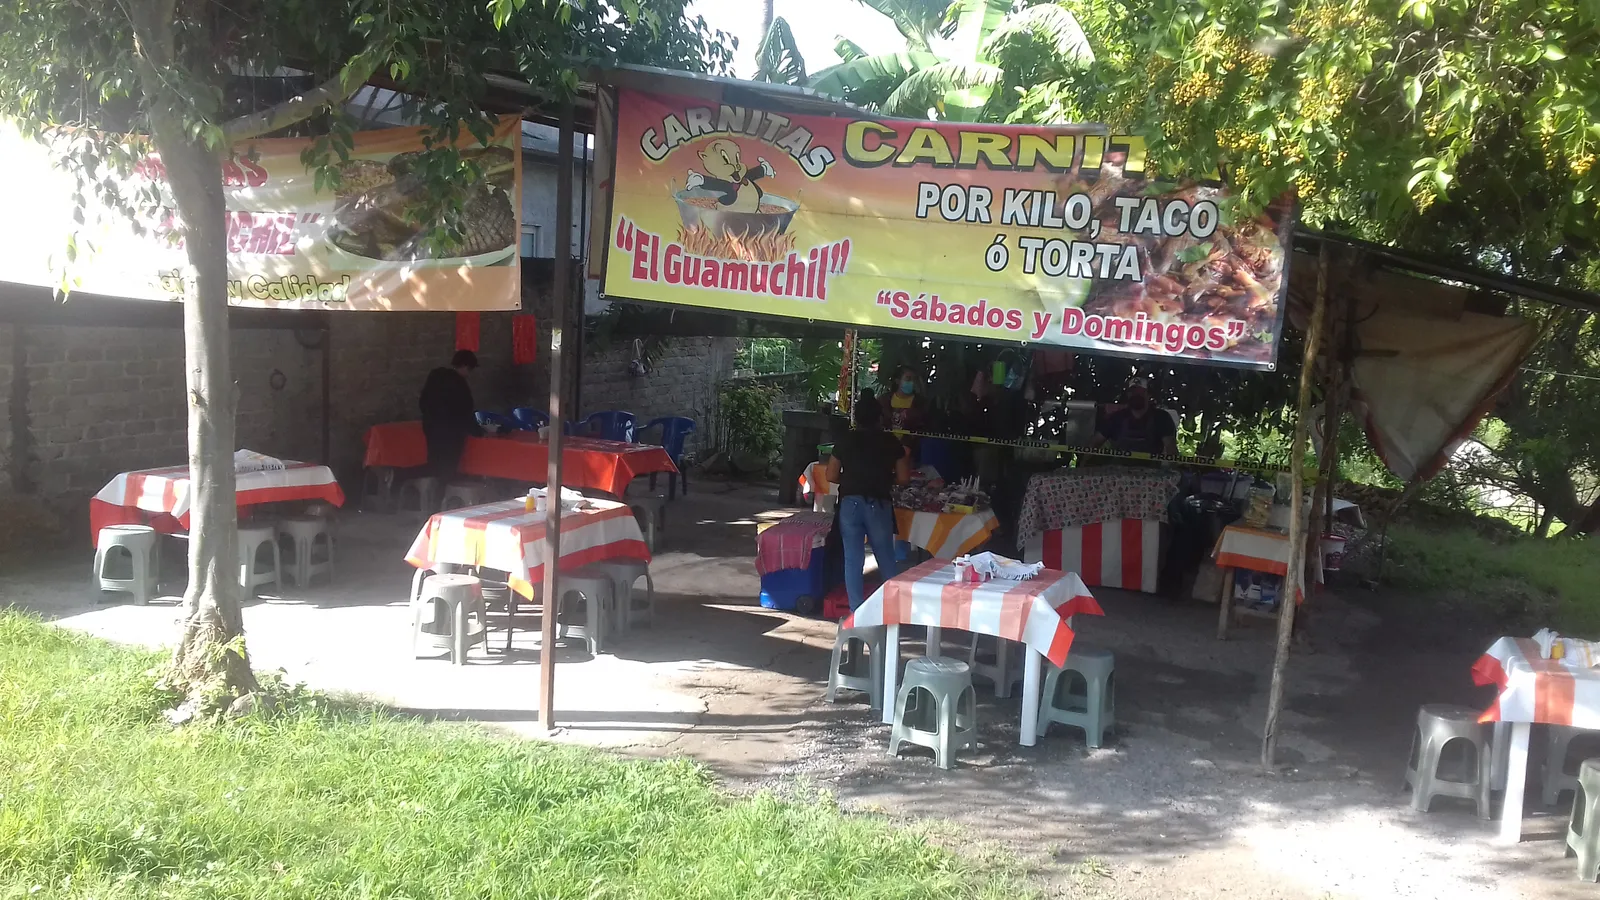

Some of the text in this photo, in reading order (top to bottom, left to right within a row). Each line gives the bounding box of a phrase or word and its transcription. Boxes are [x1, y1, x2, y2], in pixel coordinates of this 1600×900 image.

[640, 104, 836, 178] CARNITAS
[842, 120, 1221, 186] CARNIT
[916, 181, 1219, 239] POR KILO, TACO
[615, 216, 851, 301] “El Guamuchil”
[984, 233, 1143, 282] ó TORTA
[247, 274, 350, 303] Calidad
[876, 289, 1246, 353] “Sábados y Domingos”
[987, 437, 1050, 449] PROHIBIDO
[1067, 445, 1132, 457] PROHIBIDO
[1150, 453, 1216, 465] PROHIBIDO
[1233, 460, 1292, 474] PROHIBID
